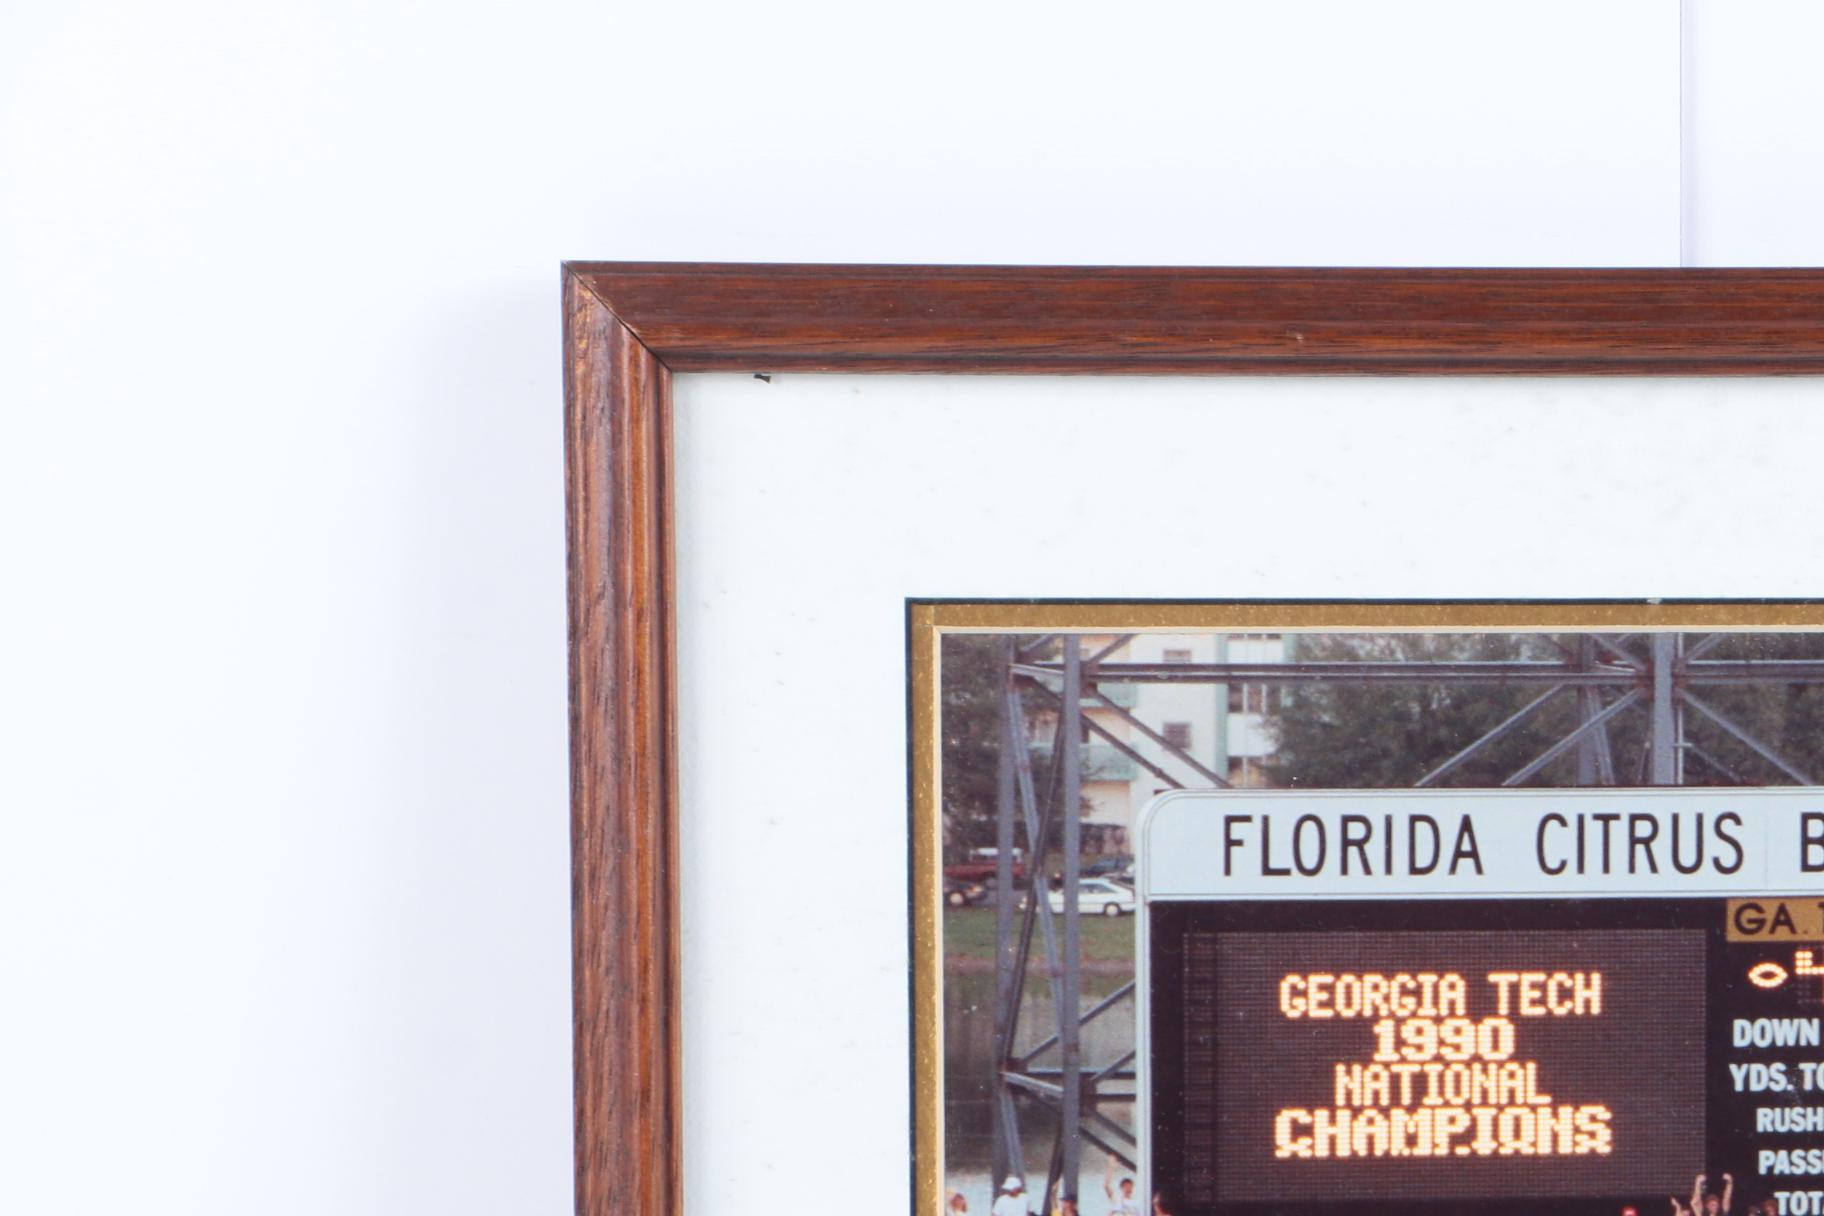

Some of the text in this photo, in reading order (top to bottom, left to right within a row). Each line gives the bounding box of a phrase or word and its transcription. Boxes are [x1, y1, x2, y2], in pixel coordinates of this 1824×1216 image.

[1223, 813, 1484, 877] FLORIDA
[1536, 811, 1745, 876] CITRUS
[1278, 971, 1603, 1019] GEORGIA TECH
[1371, 1016, 1516, 1063] 1990
[1732, 1018, 1821, 1048] DOWN
[1334, 1061, 1553, 1107] NATIONAL
[1729, 1061, 1795, 1092] YDS.
[1273, 1104, 1614, 1159] CHAMPIONS
